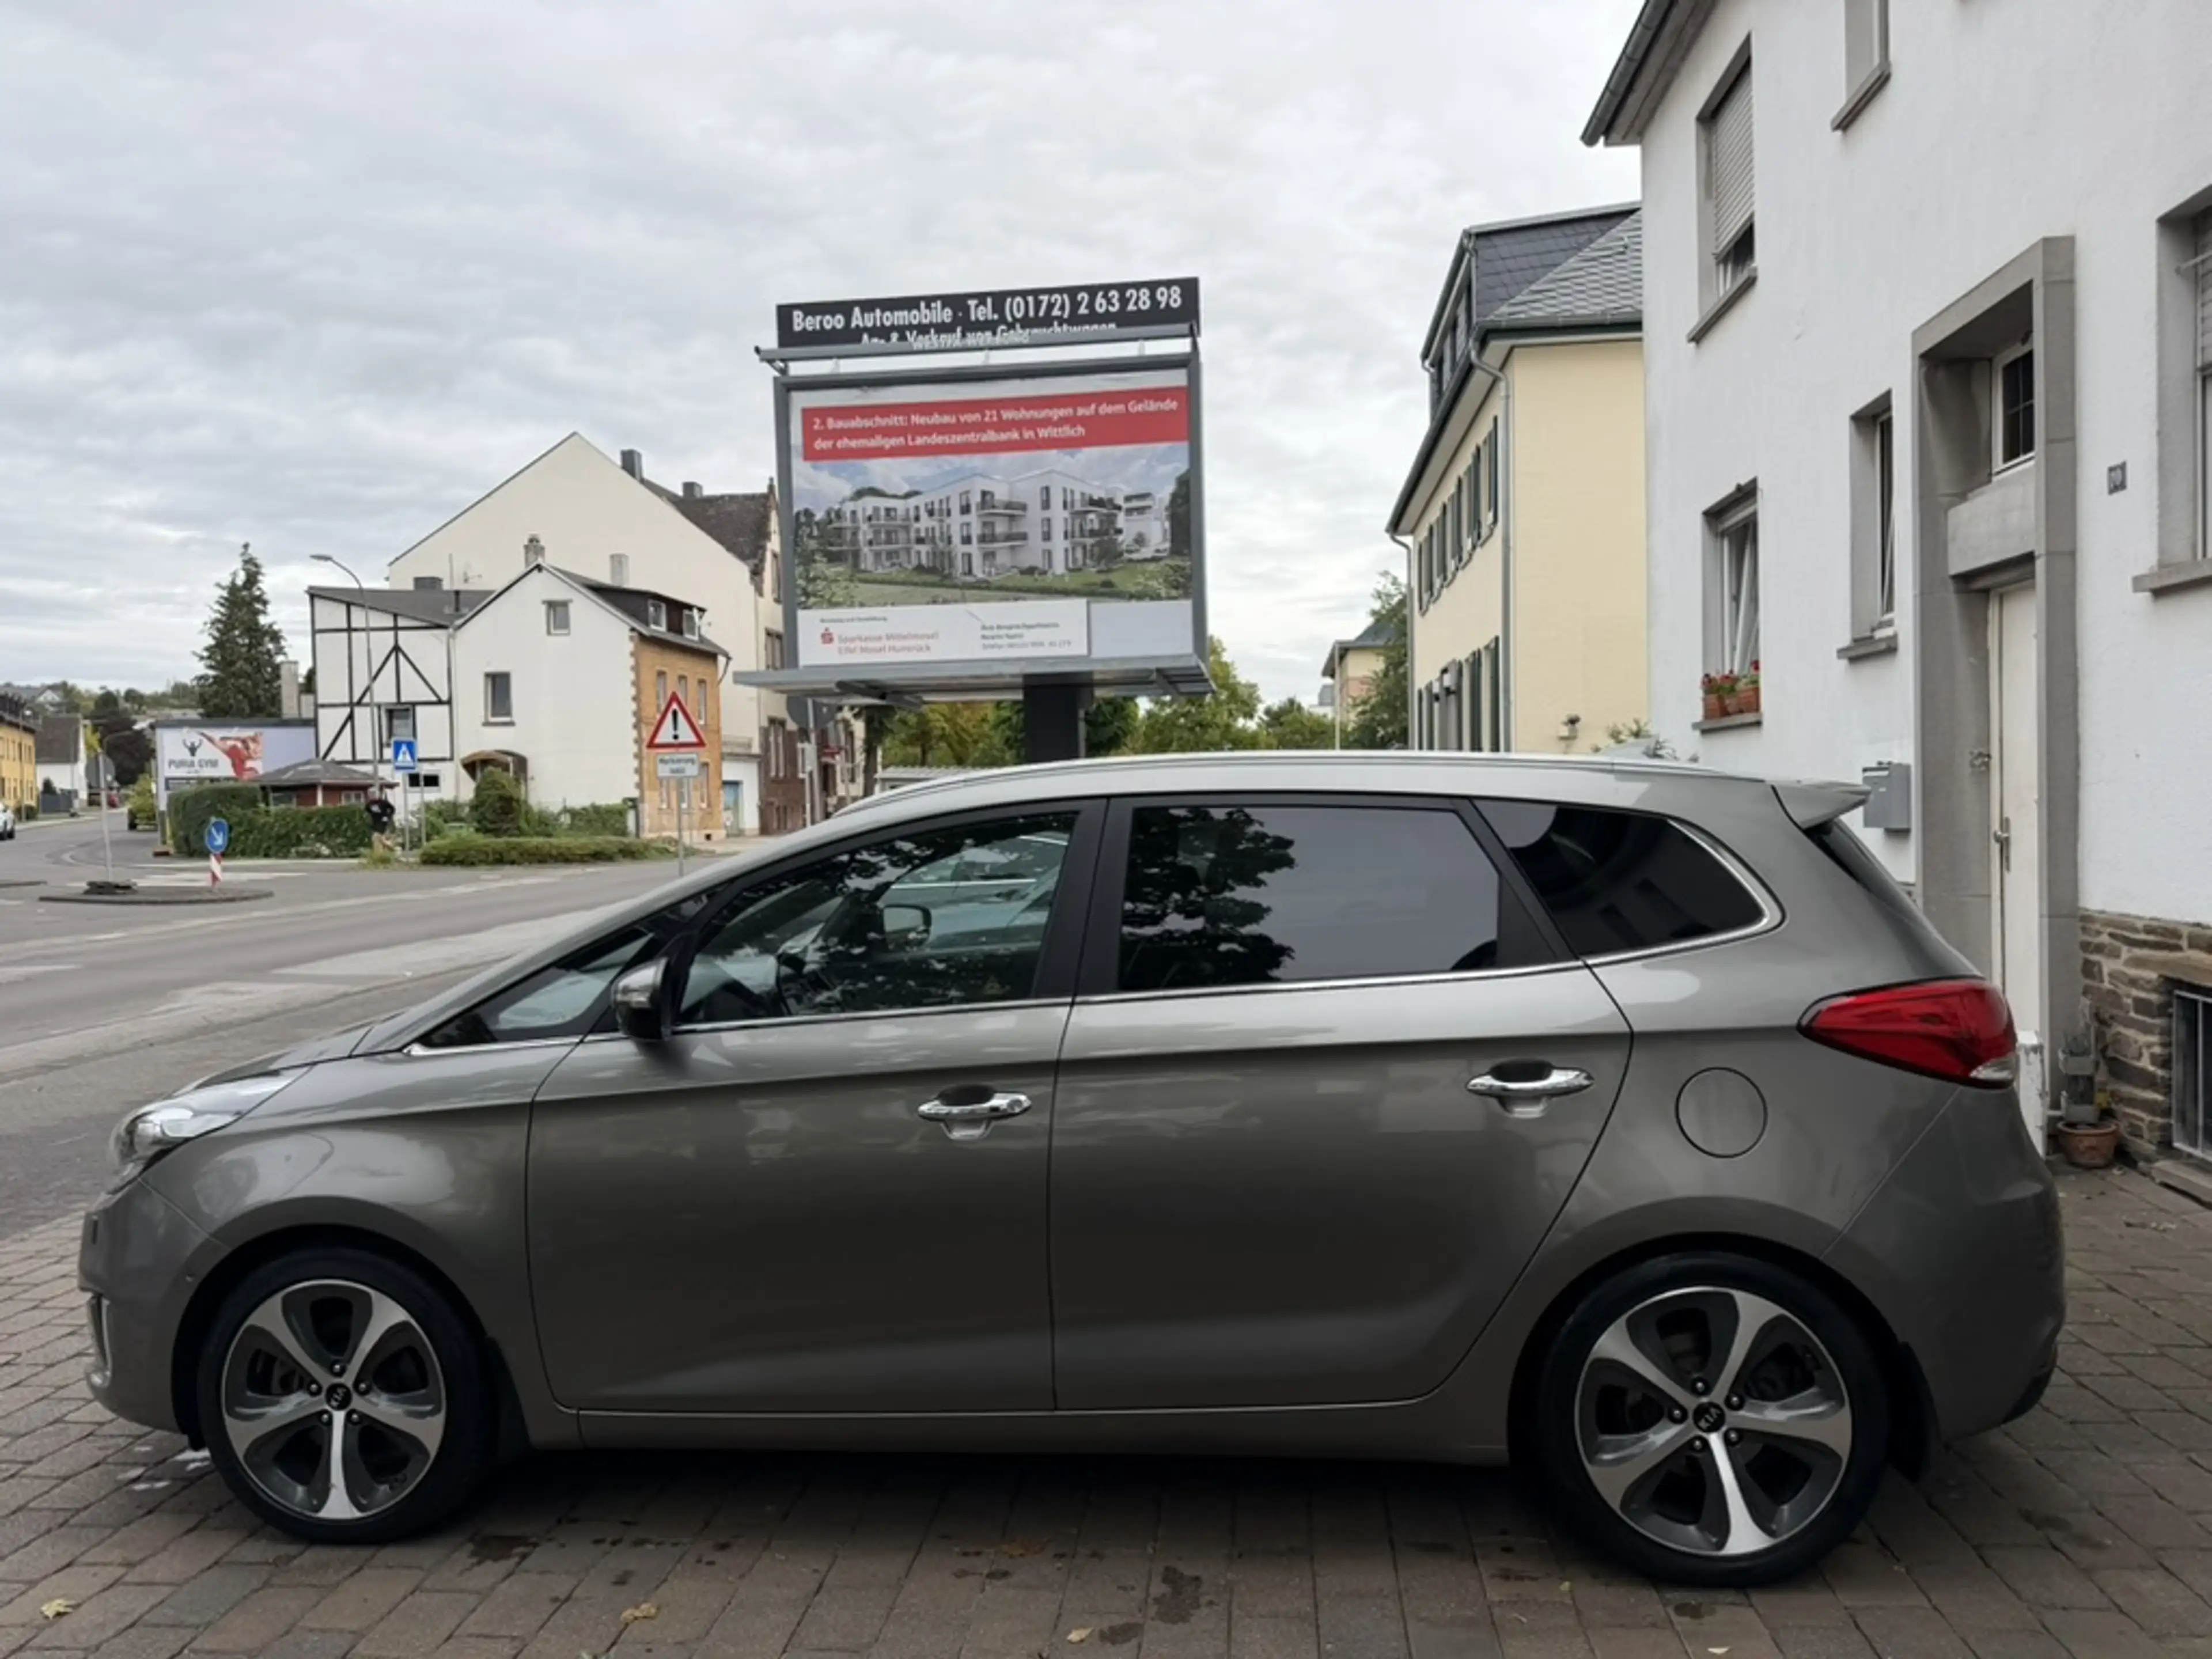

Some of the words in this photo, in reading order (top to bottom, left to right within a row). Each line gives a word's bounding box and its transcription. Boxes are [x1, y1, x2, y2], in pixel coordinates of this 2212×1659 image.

[792, 310, 845, 332] Beroo
[850, 300, 953, 329] Automobile
[967, 297, 999, 321] Tel.
[1004, 293, 1070, 323] (0172)
[1077, 291, 1090, 315] 2
[1094, 290, 1120, 313] 63
[1126, 288, 1151, 312] 28
[1156, 285, 1182, 309] 98
[813, 417, 824, 431] 2.
[827, 414, 908, 430] Bauabschnitt:
[911, 410, 955, 426] Neubau
[959, 411, 981, 423] von
[984, 410, 998, 422] 21
[1000, 405, 1074, 422] Wohnungen
[1076, 403, 1096, 416] auf
[1098, 402, 1126, 415] dem
[1127, 398, 1178, 414] Gelände
[813, 437, 834, 450] der
[836, 434, 906, 450] ehemaligen
[907, 428, 1020, 446] Landeszentralbank
[1022, 428, 1036, 440] in
[1037, 424, 1085, 438] Wittlich
